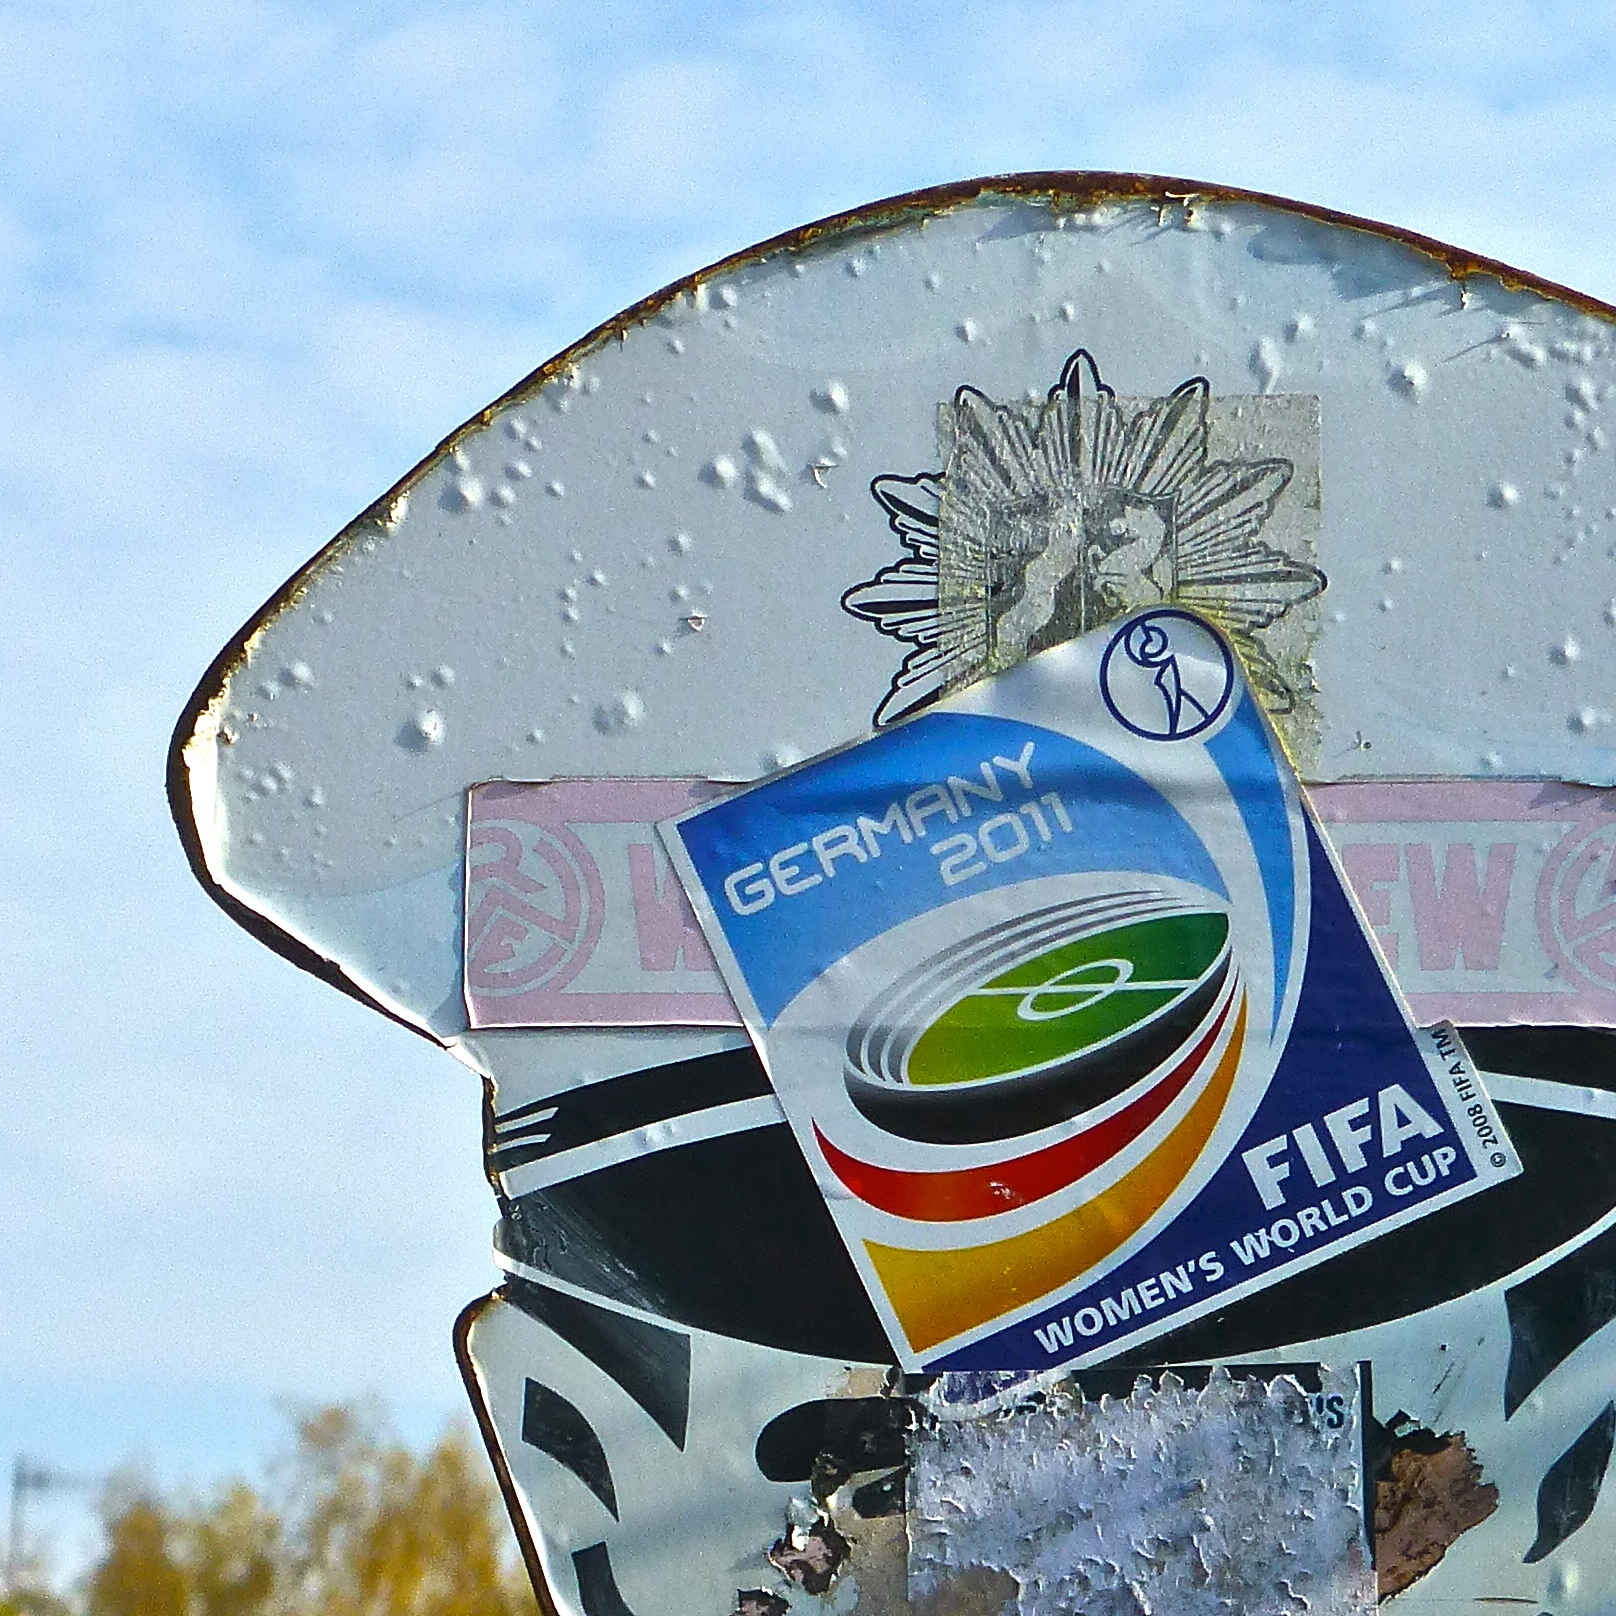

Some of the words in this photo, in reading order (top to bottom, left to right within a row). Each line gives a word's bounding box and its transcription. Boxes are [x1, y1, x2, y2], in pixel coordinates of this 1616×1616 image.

[724, 741, 1036, 916] GERMANY
[930, 791, 1074, 887] 2011
[1430, 1028, 1456, 1061] TM
[1448, 1060, 1477, 1102] FIFA
[1241, 1083, 1445, 1211] FIFA
[1467, 1103, 1499, 1150] 2008
[1033, 1250, 1225, 1355] WOMEN'S
[1229, 1185, 1374, 1279] WORLD
[1384, 1145, 1458, 1197] CUP
